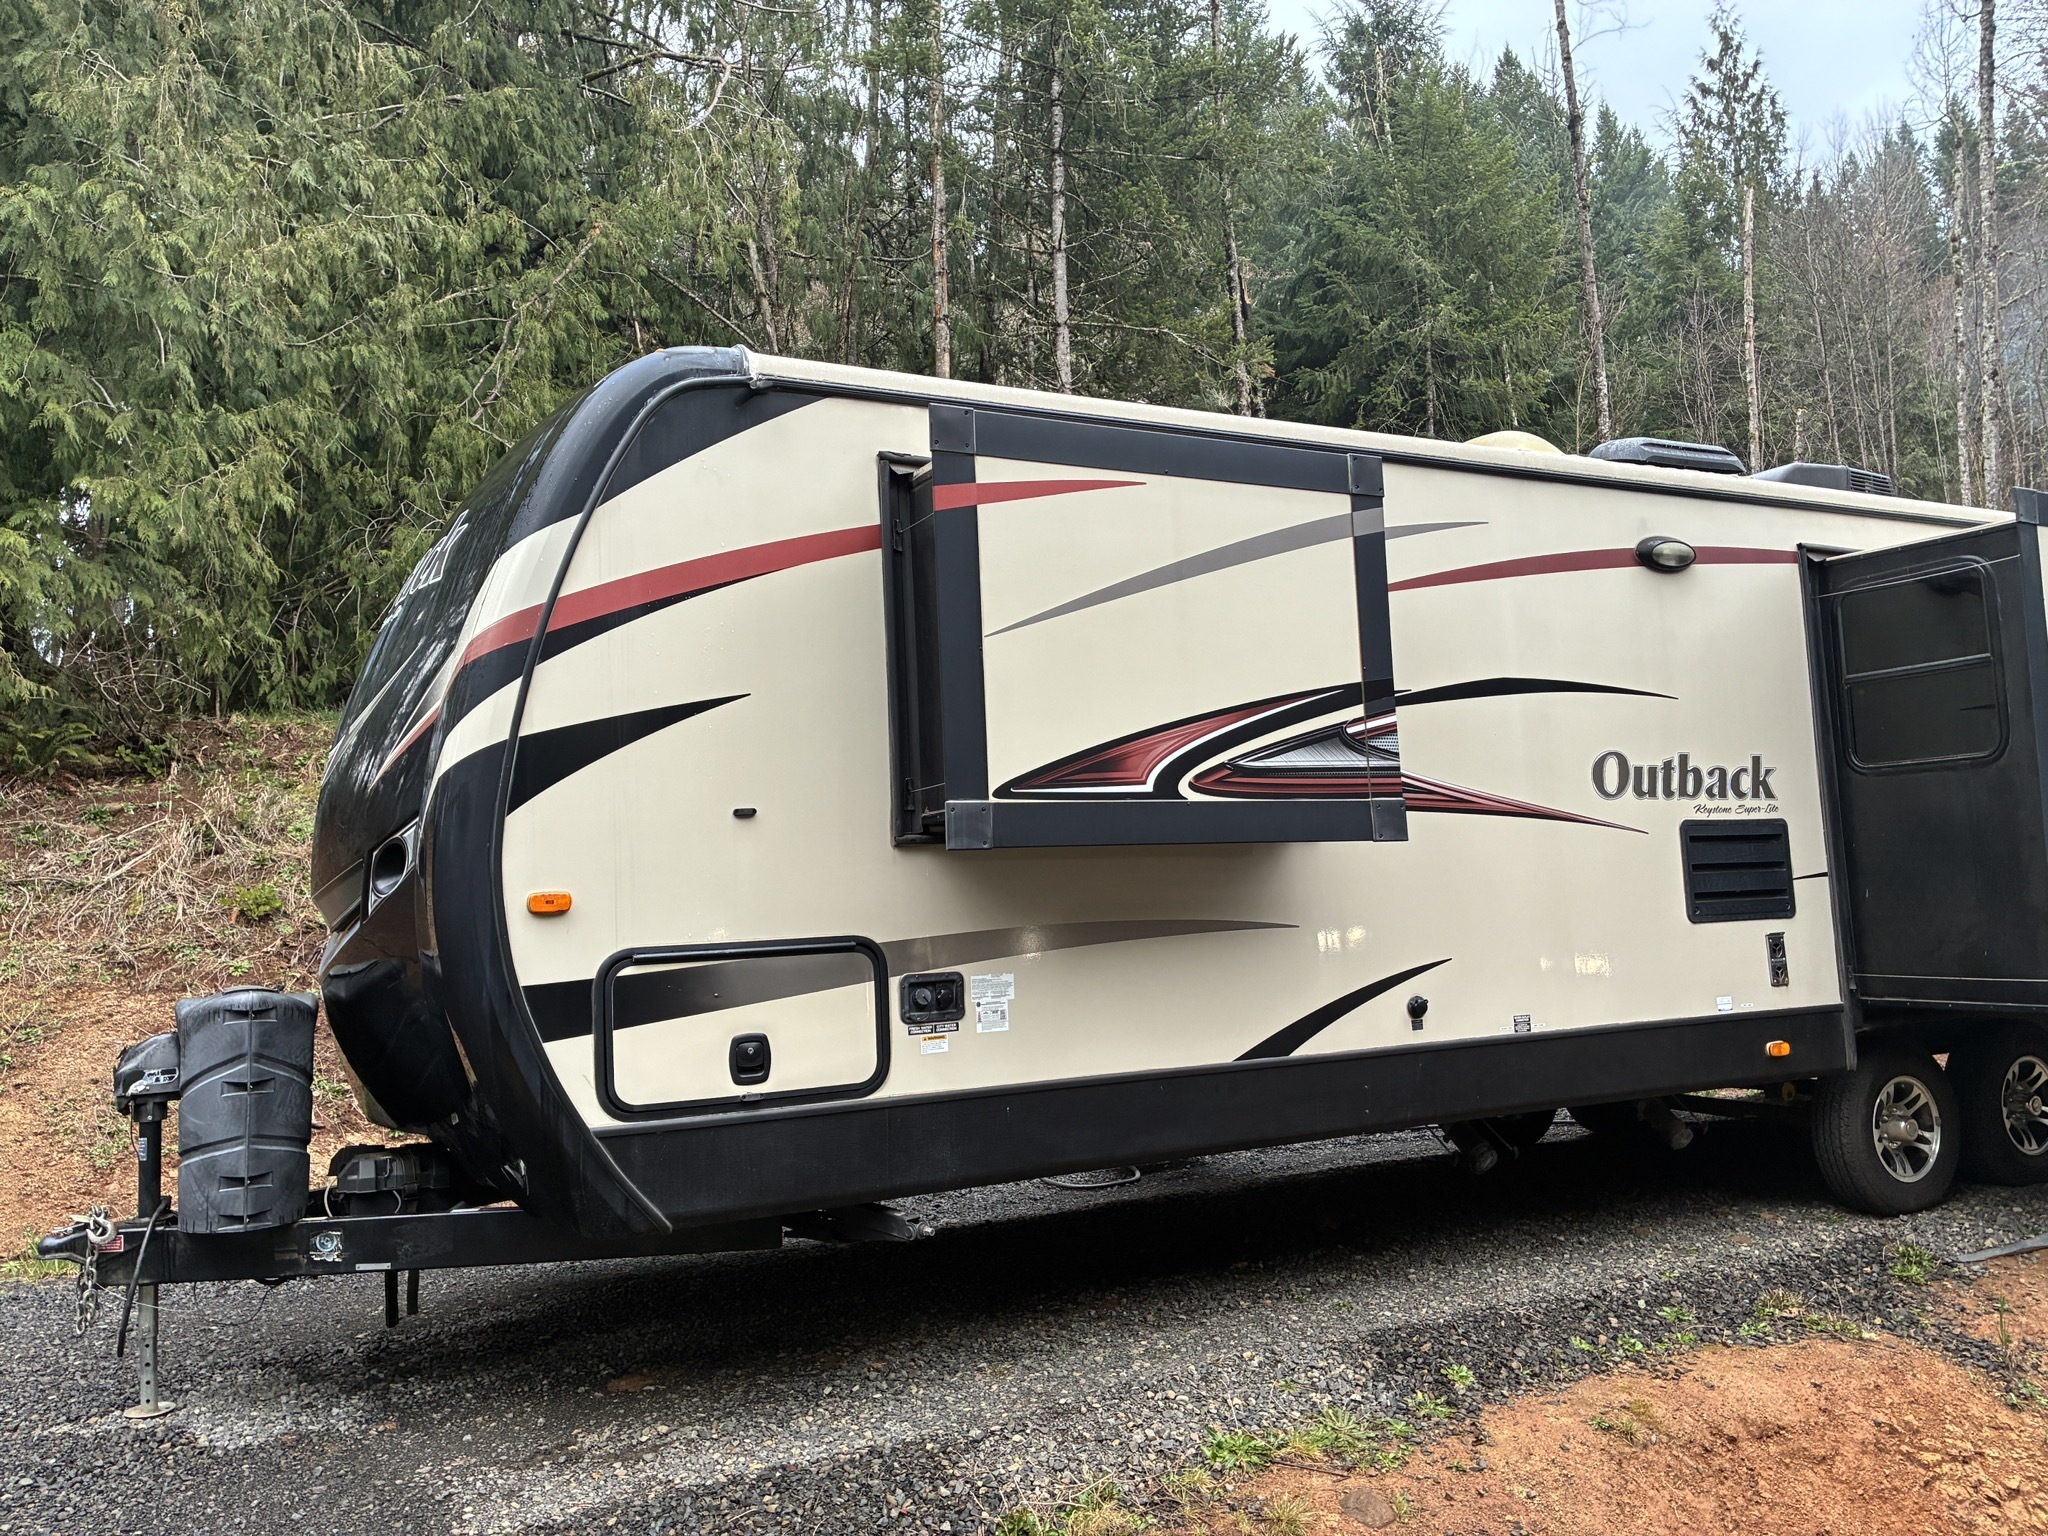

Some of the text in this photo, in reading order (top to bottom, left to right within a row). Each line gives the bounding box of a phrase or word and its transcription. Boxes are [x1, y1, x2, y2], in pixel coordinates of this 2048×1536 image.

[1591, 750, 1778, 801] Outback
[1693, 803, 1779, 818] Keystone Super-Lite
